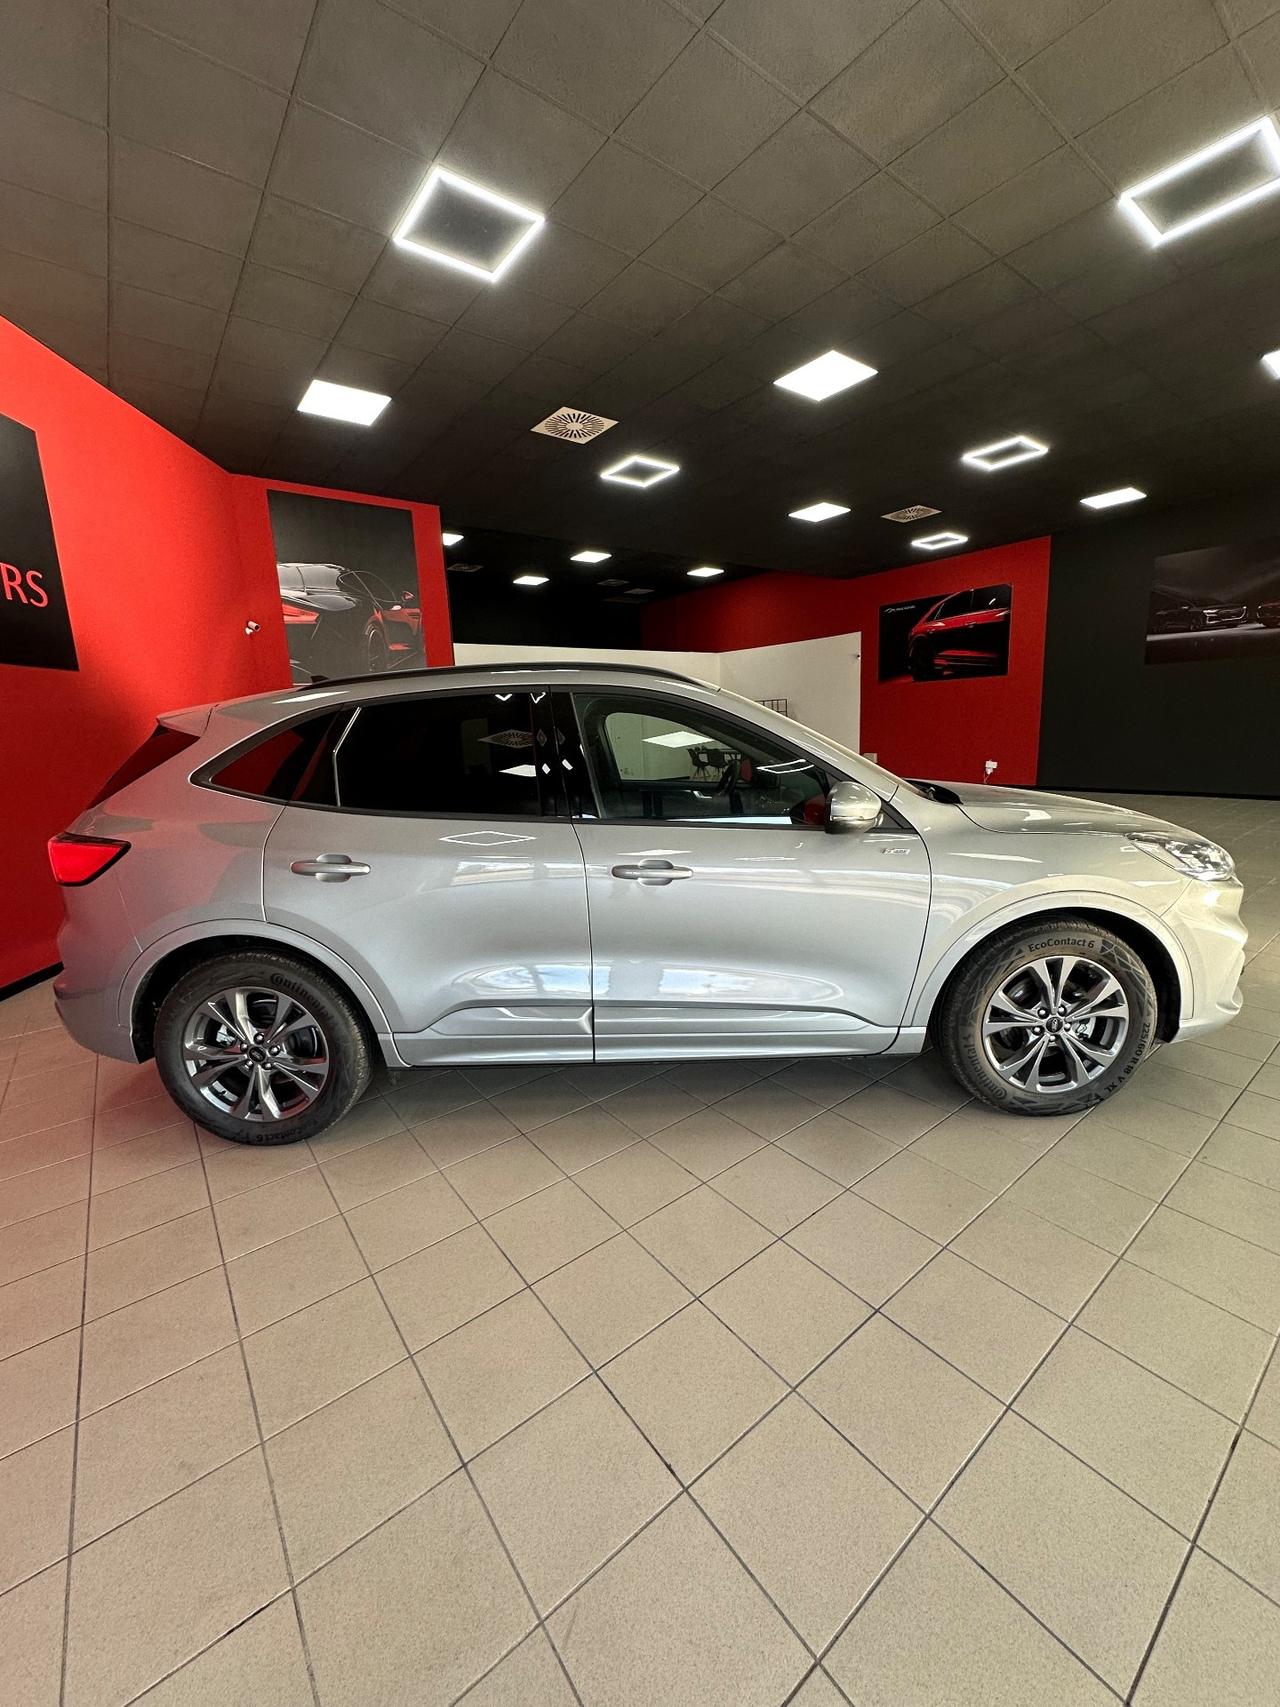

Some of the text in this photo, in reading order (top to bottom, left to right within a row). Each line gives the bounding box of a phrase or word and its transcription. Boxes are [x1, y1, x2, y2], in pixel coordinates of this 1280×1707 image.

[1028, 937, 1096, 953] EcoContact 6
[270, 972, 336, 1021] Continental
[1135, 1022, 1151, 1057] 225/60
[964, 1043, 1008, 1100] Continental
[1117, 1075, 1126, 1083] V
[1104, 1082, 1118, 1093] XL
